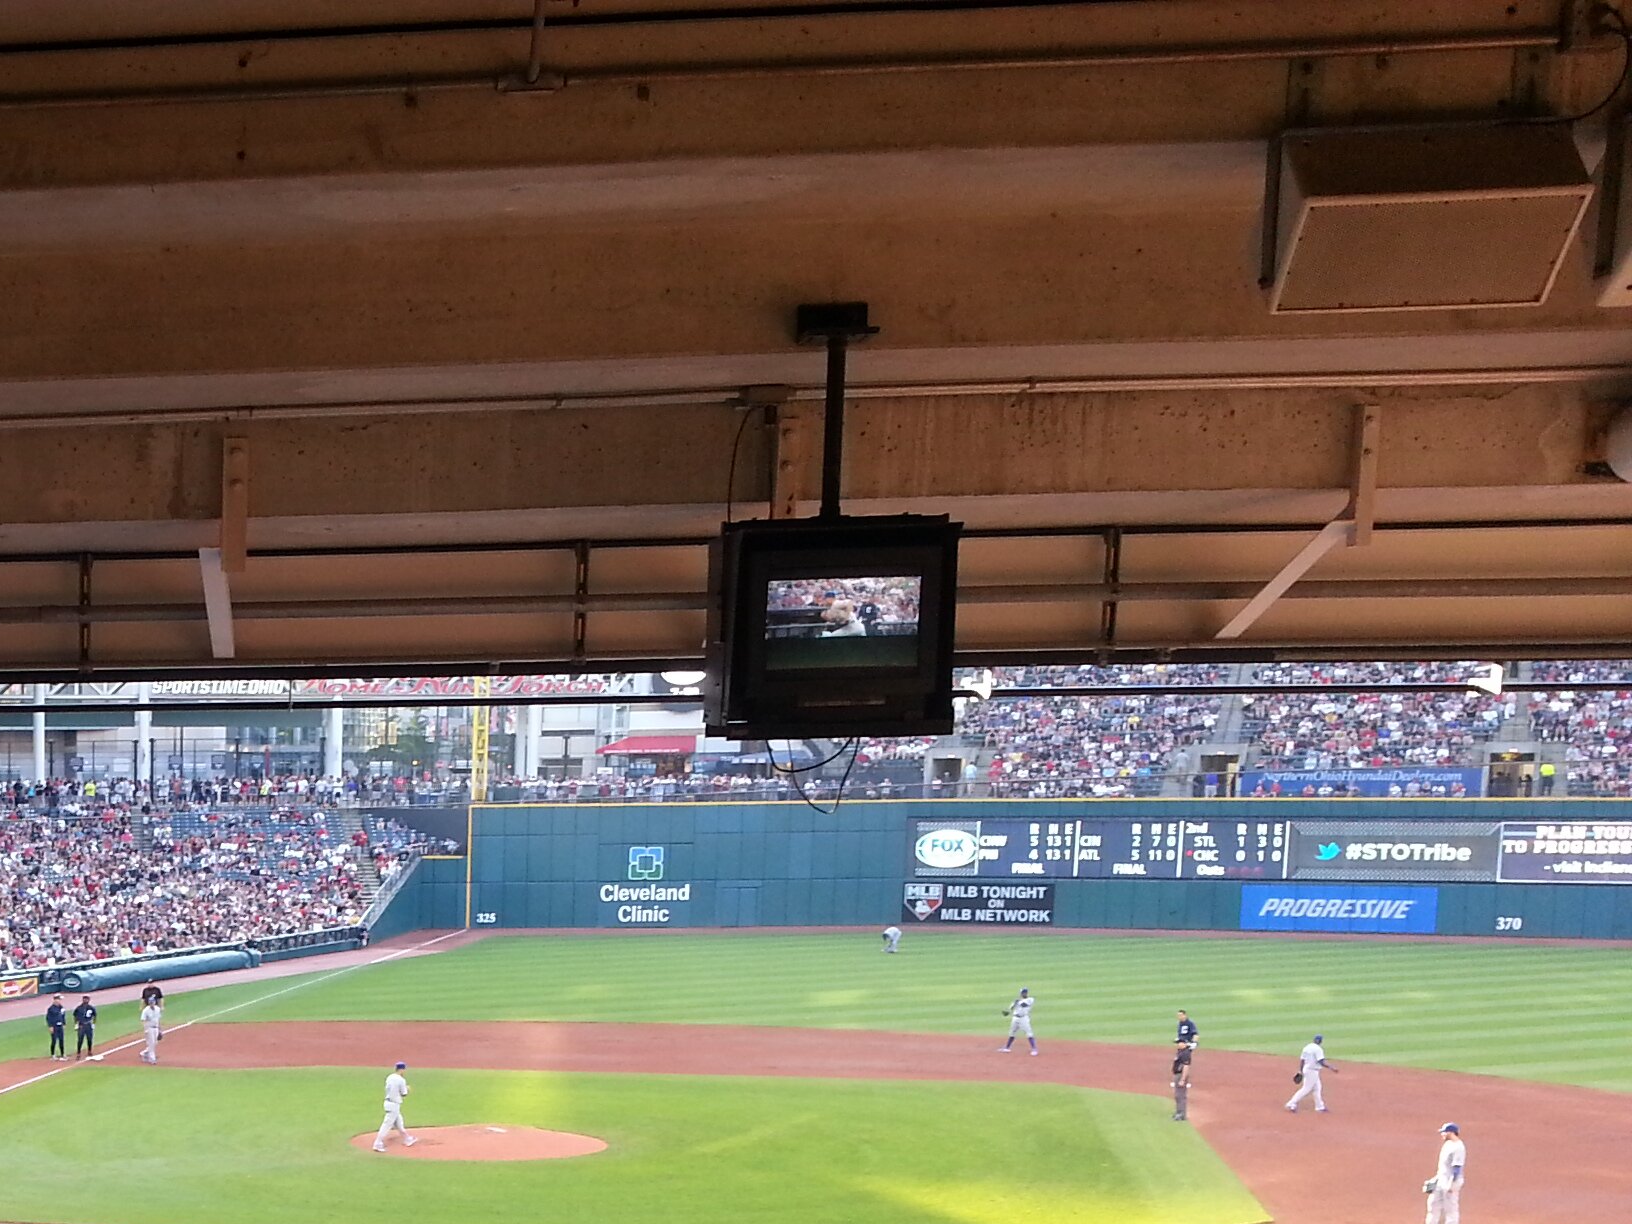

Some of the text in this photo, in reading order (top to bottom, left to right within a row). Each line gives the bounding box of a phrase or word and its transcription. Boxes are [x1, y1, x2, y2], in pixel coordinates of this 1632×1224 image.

[931, 839, 965, 852] FOX
[1132, 835, 1141, 847] 2
[1152, 835, 1161, 847] 7
[1194, 836, 1216, 847] STL
[1502, 840, 1527, 854] TO
[1078, 849, 1101, 861] ATL
[1131, 849, 1140, 861] 5
[1148, 849, 1162, 861] 11
[1345, 842, 1472, 862] #STOTribe
[599, 883, 691, 902] Cleveland
[908, 885, 940, 896] MLB
[947, 886, 1047, 899] MLB TONIGHT
[988, 899, 1005, 908] ON
[1259, 898, 1417, 920] PROGRESSIVE
[476, 912, 497, 924] 325
[617, 905, 670, 923] Clinic
[941, 908, 1051, 923] MLB NETWORK
[1495, 917, 1522, 931] 370
